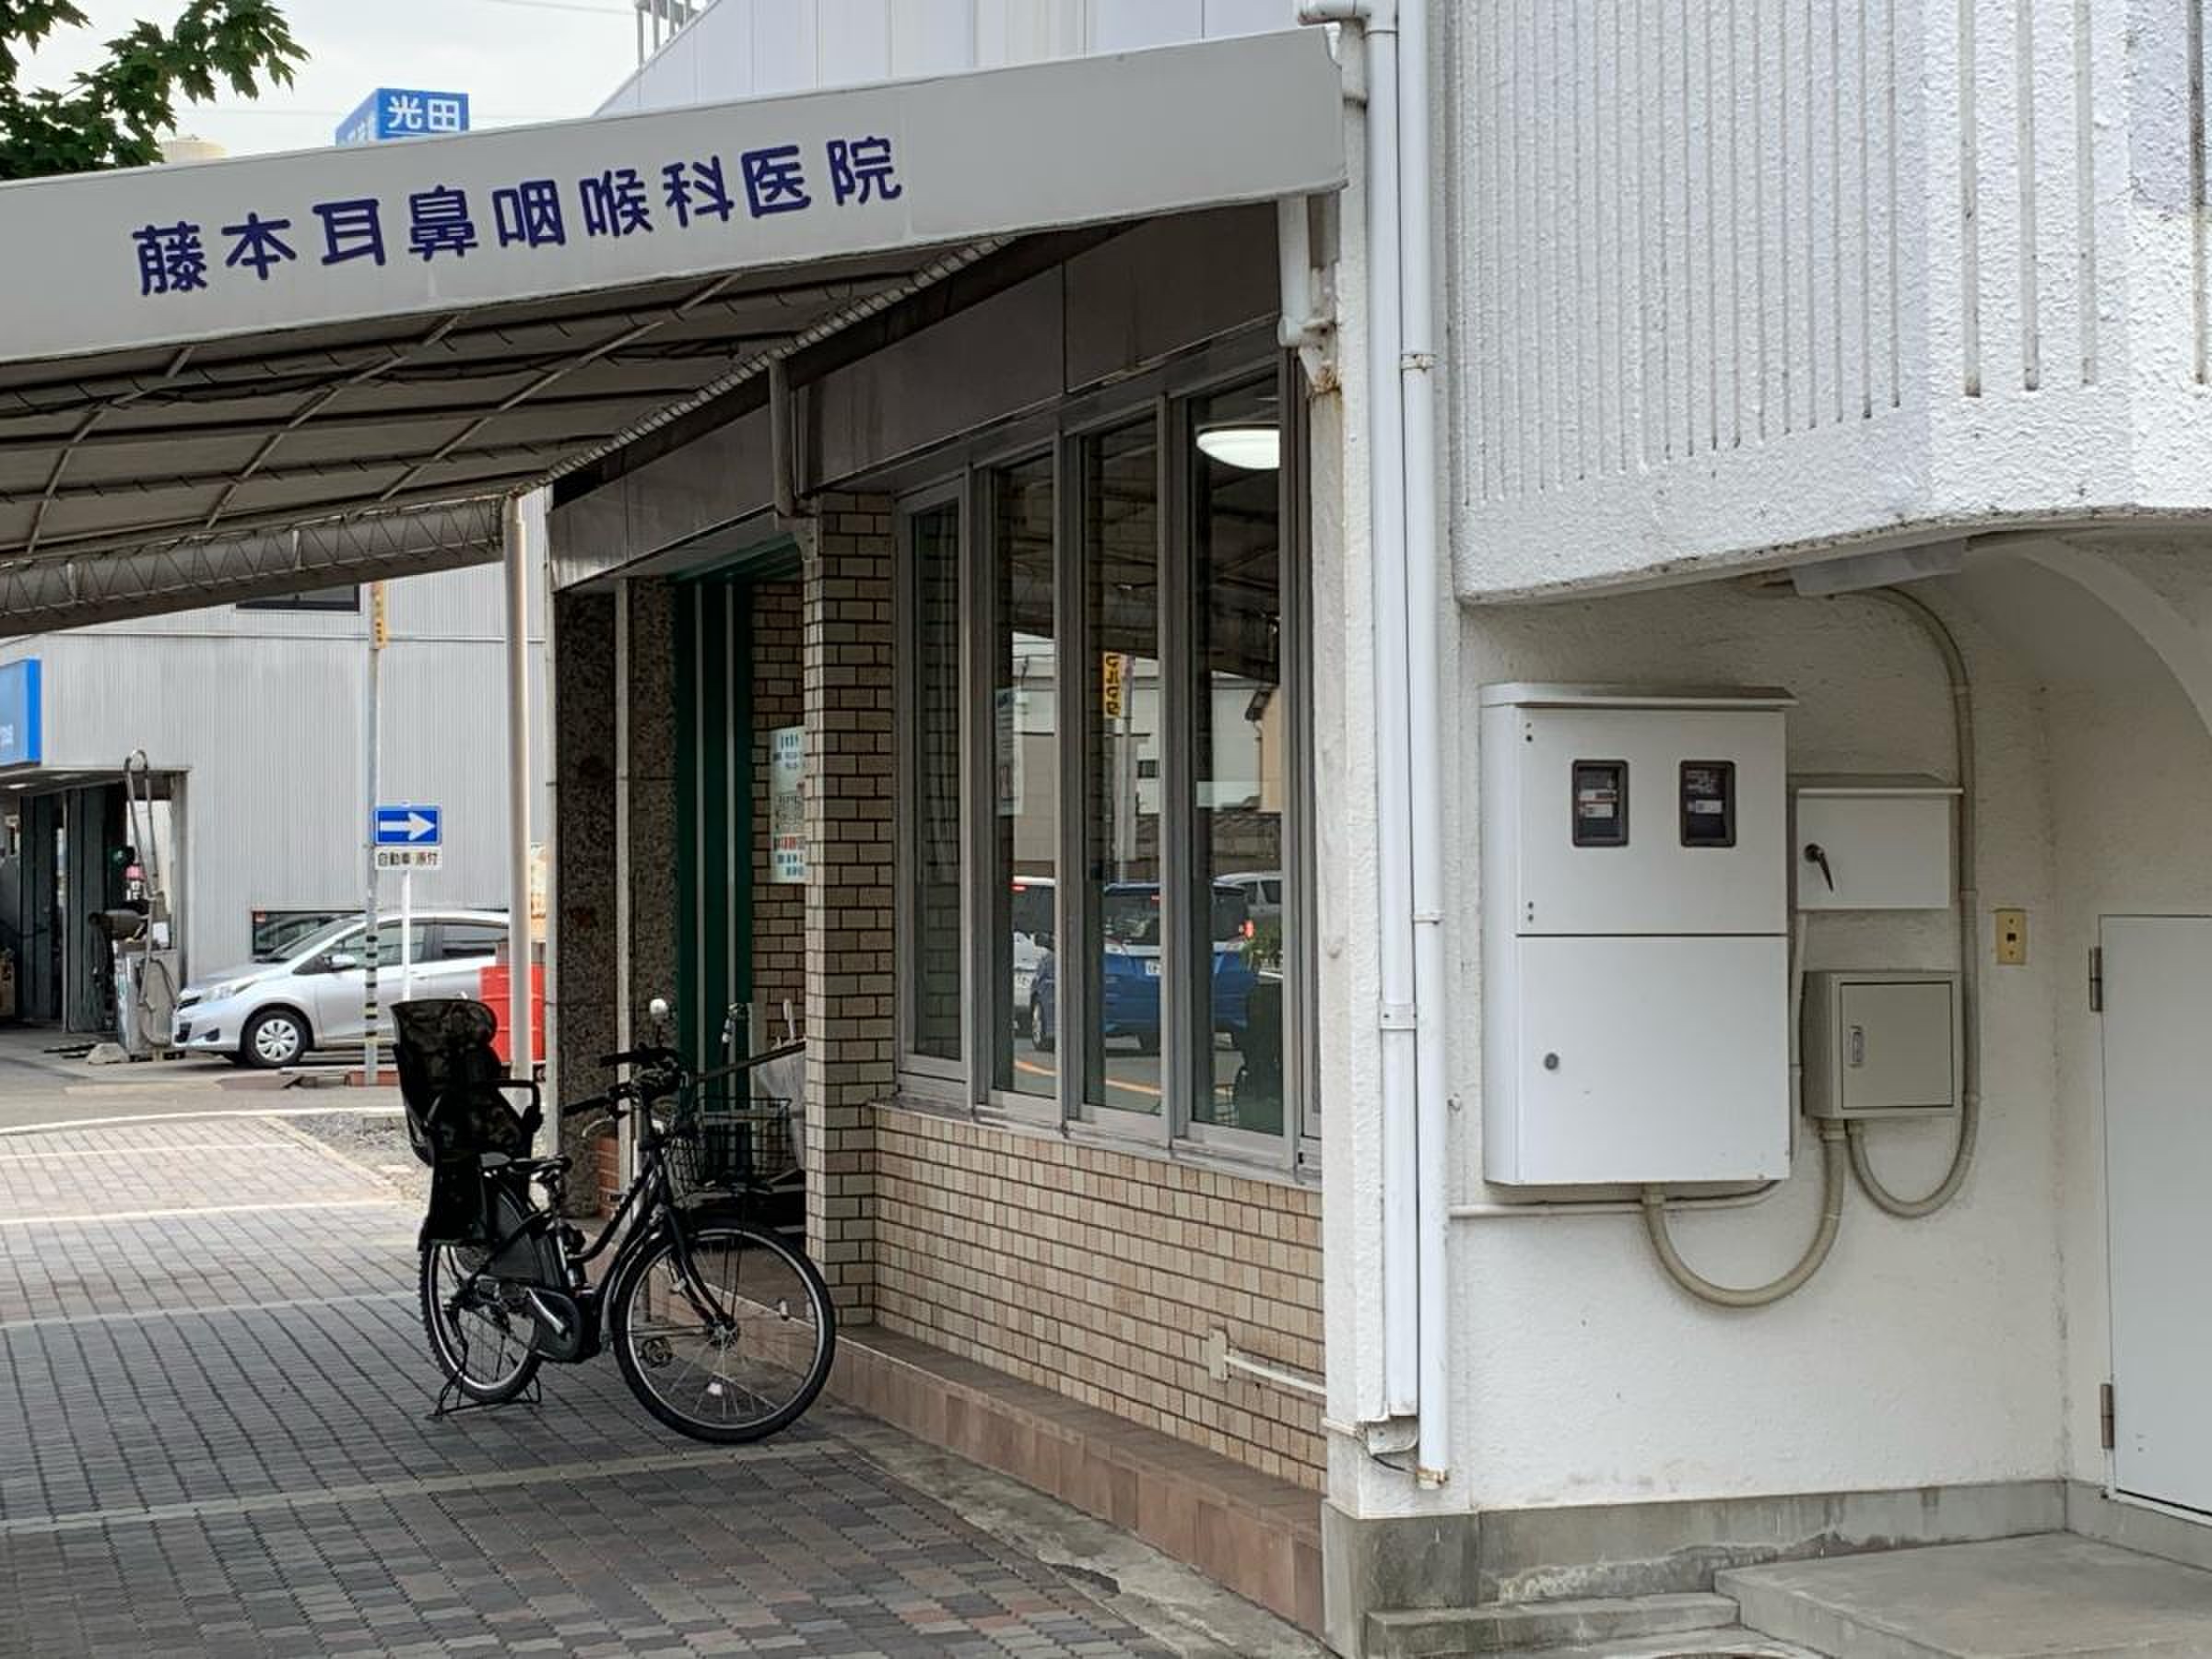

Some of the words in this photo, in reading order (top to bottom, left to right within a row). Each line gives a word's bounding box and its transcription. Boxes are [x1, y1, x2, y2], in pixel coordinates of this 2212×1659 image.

[387, 95, 461, 131] 光田
[133, 135, 901, 296] 藤本耳鼻咽喉科医院
